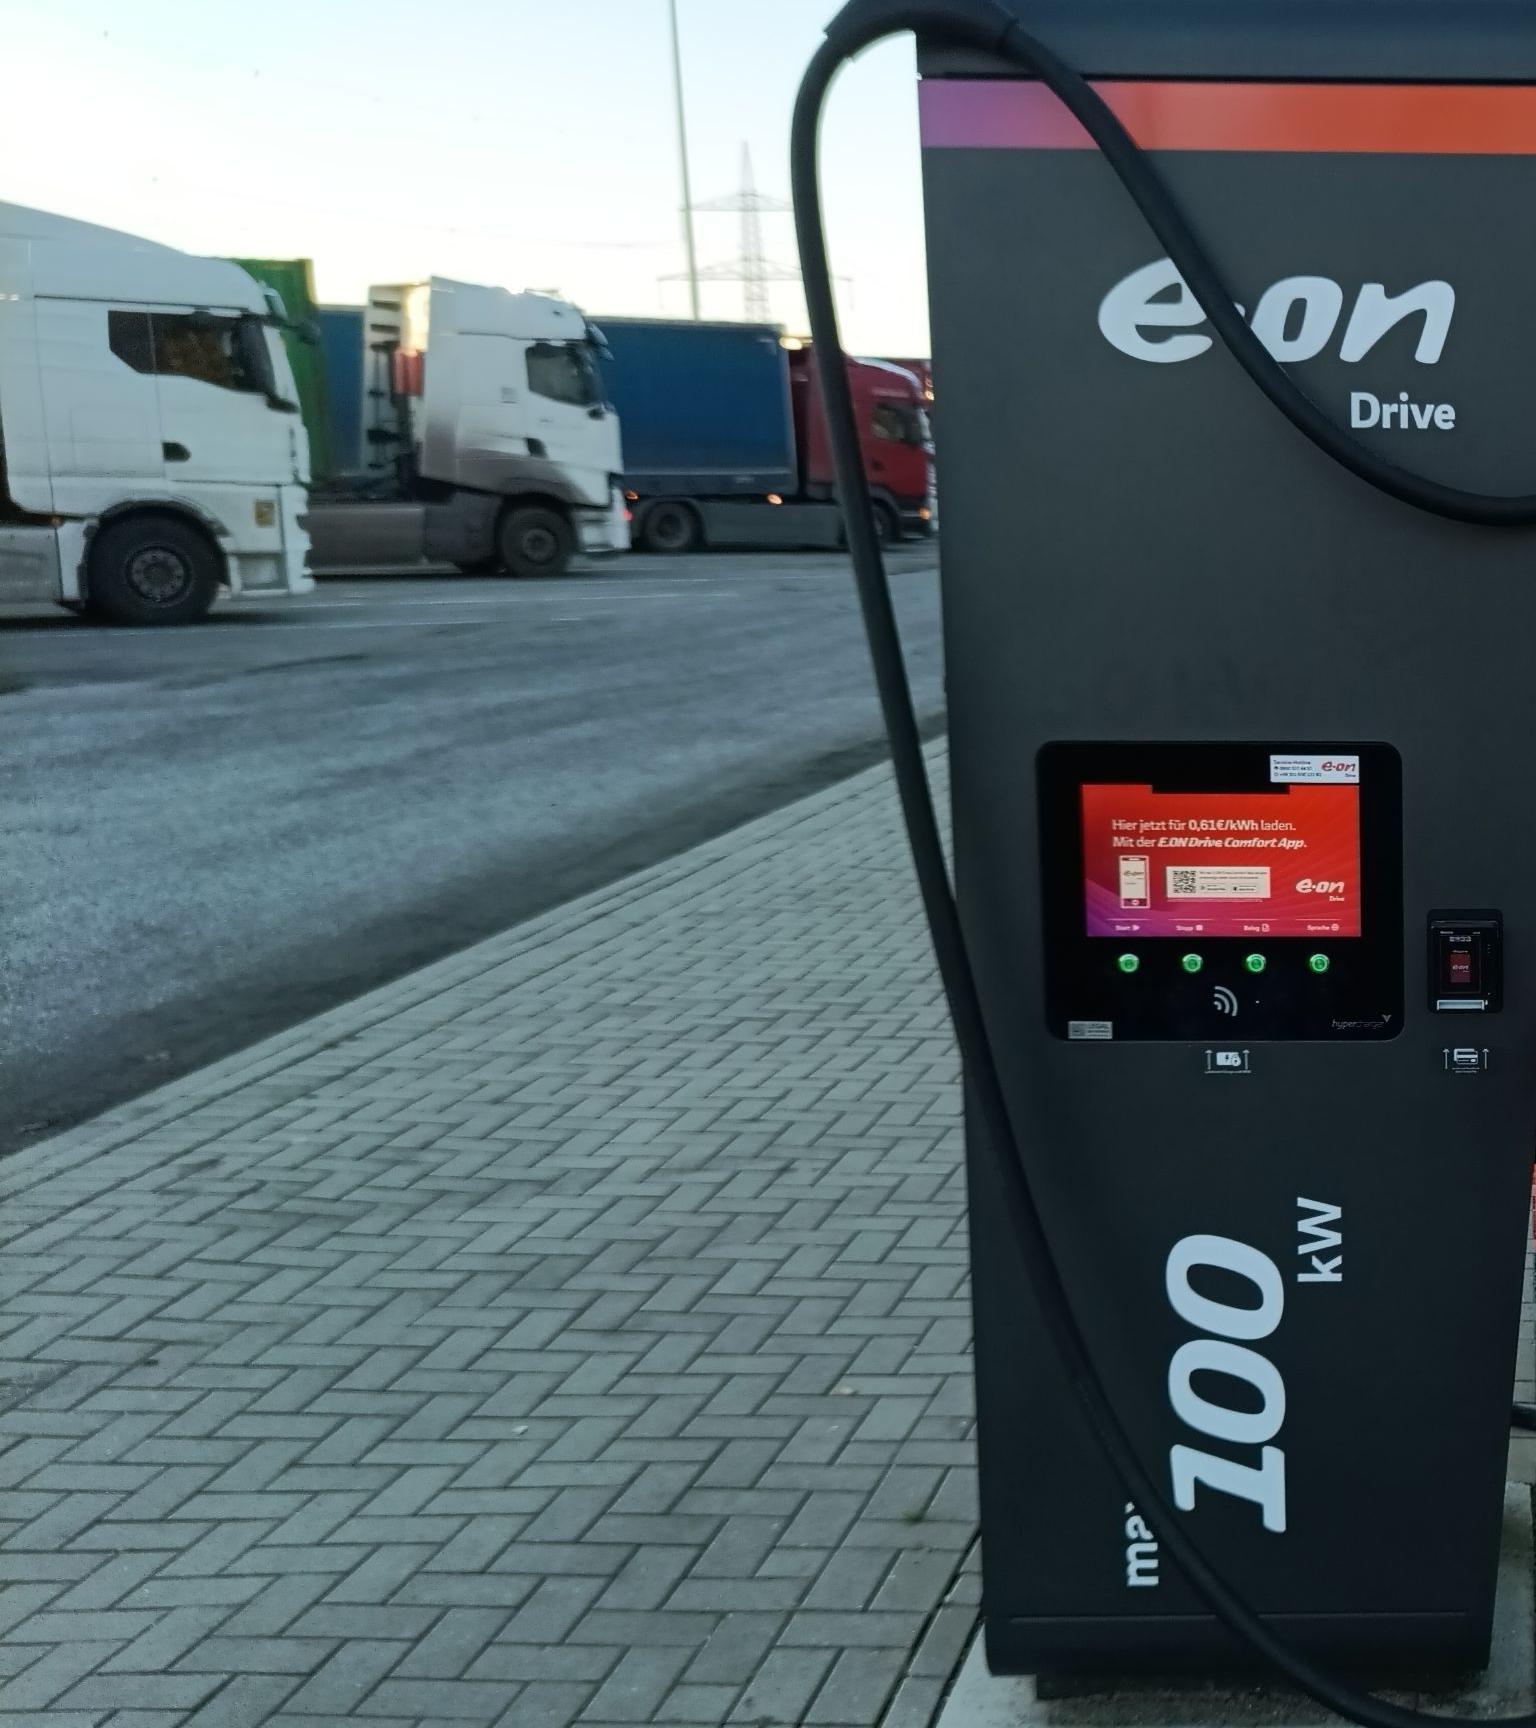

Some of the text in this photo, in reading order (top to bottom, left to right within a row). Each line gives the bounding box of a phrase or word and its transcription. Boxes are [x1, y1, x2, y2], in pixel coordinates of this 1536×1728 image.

[1098, 257, 1456, 365] eon
[1350, 391, 1456, 430] Drive
[1111, 818, 1297, 834] Hier jetzt für 0,61€/kWh laden.
[1112, 836, 1134, 848] Mit
[1136, 836, 1157, 848] der
[1188, 836, 1223, 848] Drive
[1224, 837, 1278, 848] Comfort
[1278, 837, 1308, 850] App.
[1297, 1197, 1343, 1283] kW
[1166, 1235, 1287, 1533] 100
[1126, 1501, 1159, 1587] ma
